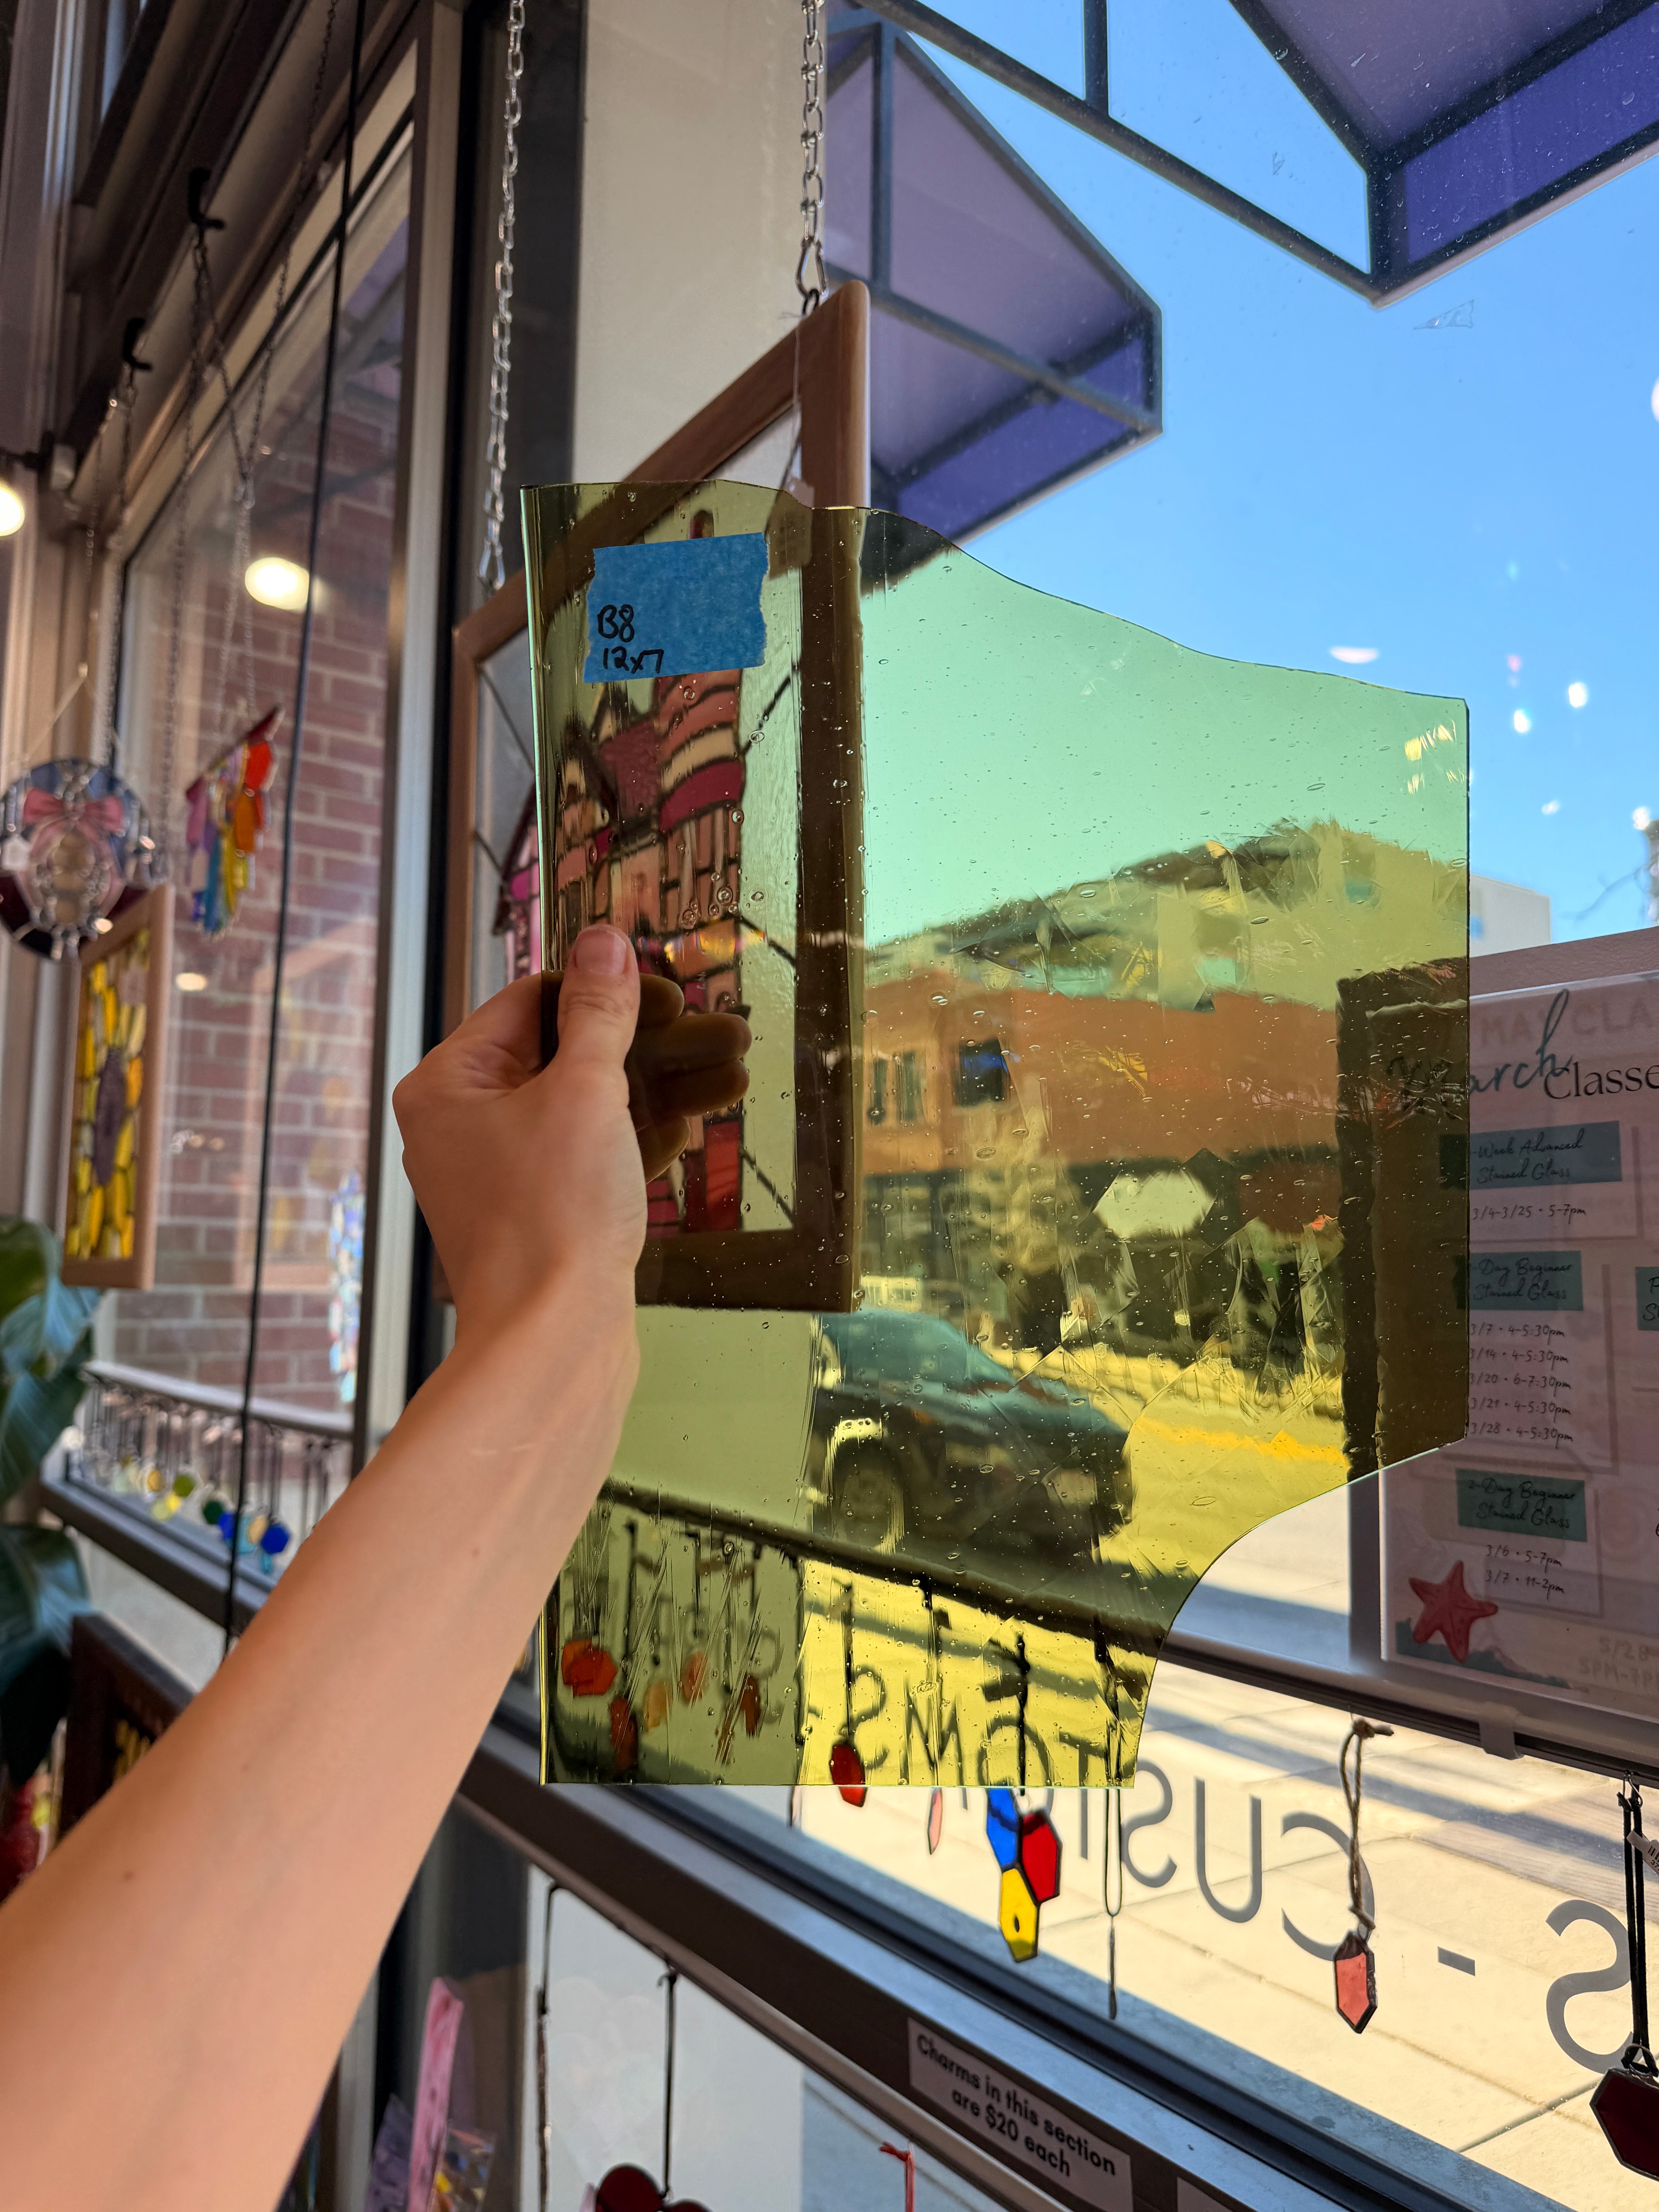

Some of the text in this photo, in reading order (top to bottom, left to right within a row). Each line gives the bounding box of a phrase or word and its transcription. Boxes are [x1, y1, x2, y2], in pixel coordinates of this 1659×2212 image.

[597, 604, 635, 642] B8
[603, 646, 664, 674] 12x7
[1471, 1128, 1585, 1158] -Week Advanced
[1477, 1158, 1570, 1183] Stained Glass
[1548, 1204, 1586, 1224] 5-7pm
[1470, 1258, 1573, 1287] -Day Beginner
[1473, 1277, 1566, 1300] Stained Glass
[1508, 1324, 1565, 1345] 4-5:30pm
[1512, 1350, 1568, 1371] 4-5:30pm
[1514, 1400, 1570, 1423] 4-5:30pm
[1516, 1426, 1573, 1449] 4-5:30pm
[1519, 1481, 1575, 1508] Beginner
[1476, 1500, 1570, 1528] Stained Glass
[1525, 1550, 1561, 1573] 5-7pm
[917, 2034, 1115, 2175] Charms in this section
[952, 2090, 1070, 2177] are $20 each
